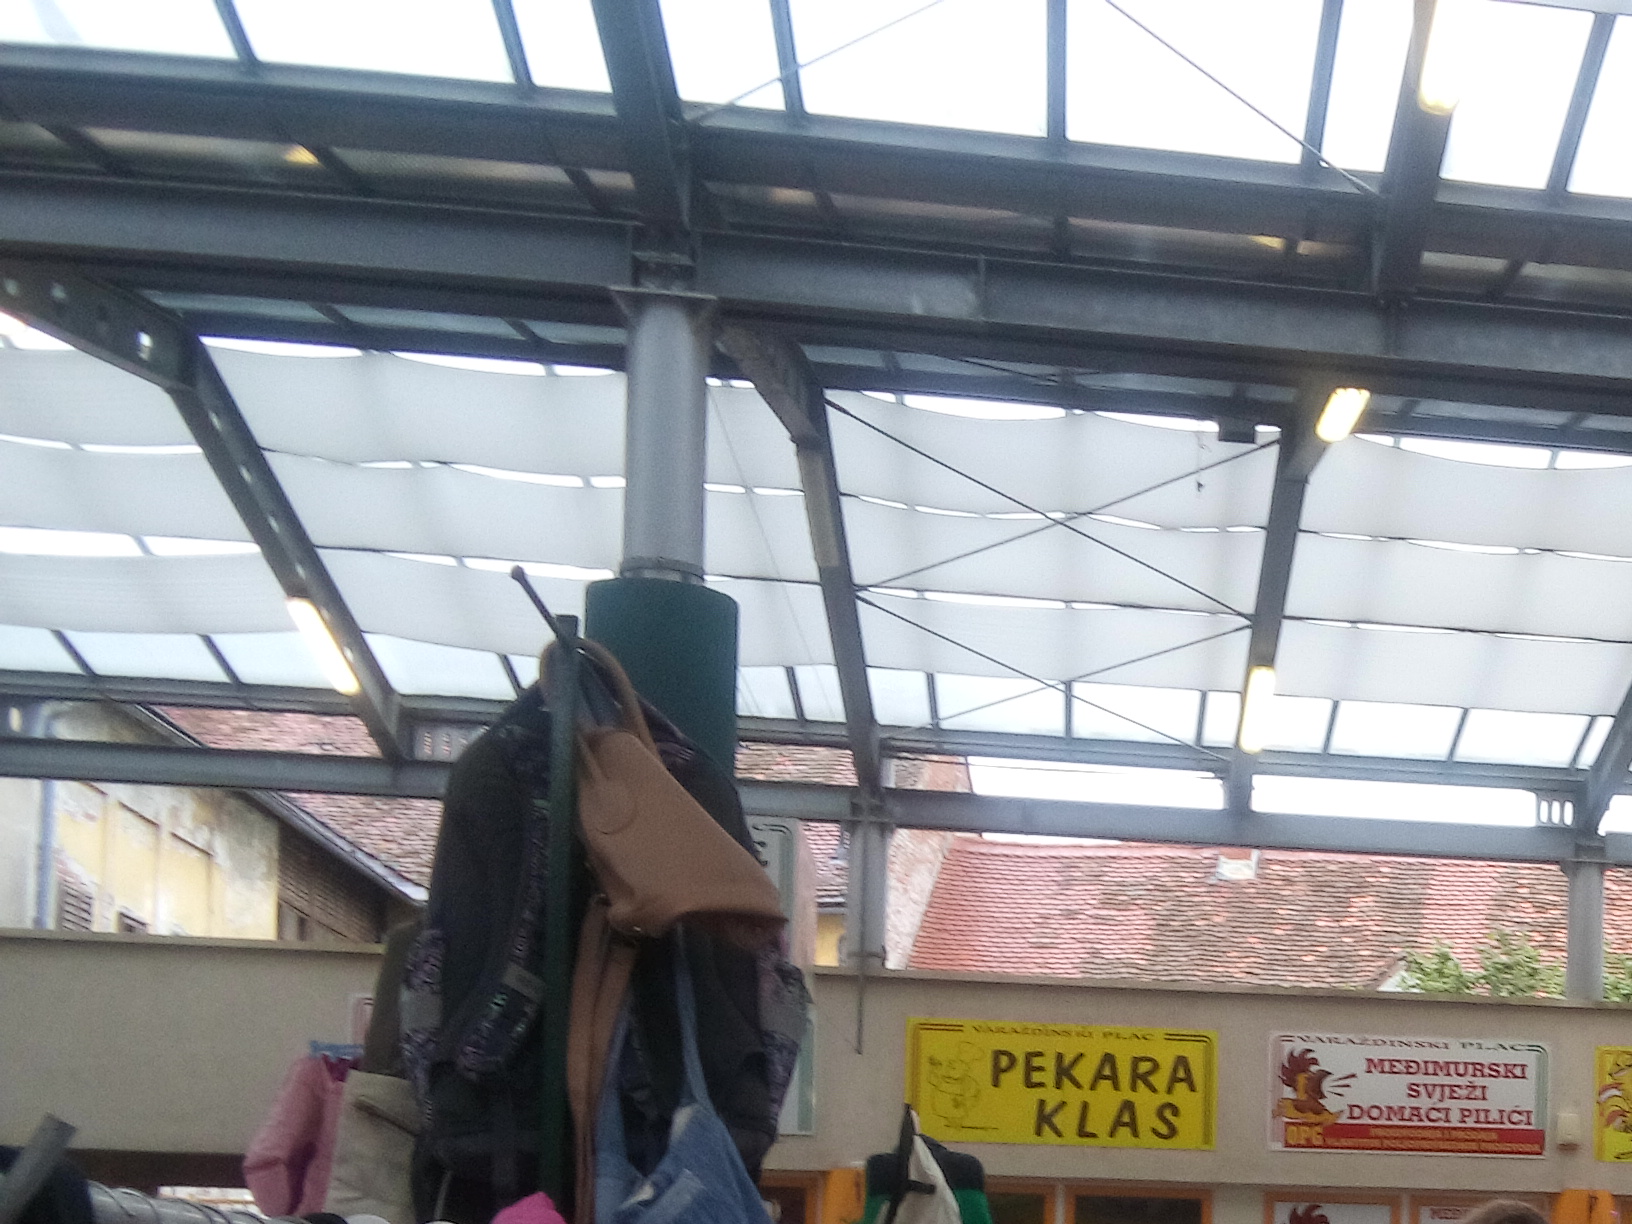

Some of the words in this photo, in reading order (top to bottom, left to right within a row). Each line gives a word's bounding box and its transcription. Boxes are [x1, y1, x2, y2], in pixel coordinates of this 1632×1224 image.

[991, 1049, 1198, 1095] PEKARA
[1365, 1057, 1529, 1079] MEĐIMURSKI
[1407, 1081, 1489, 1102] SVJEŽI
[1034, 1098, 1180, 1140] KLAS
[1346, 1101, 1453, 1124] DOMAĆI
[1458, 1105, 1534, 1126] PILIĆI
